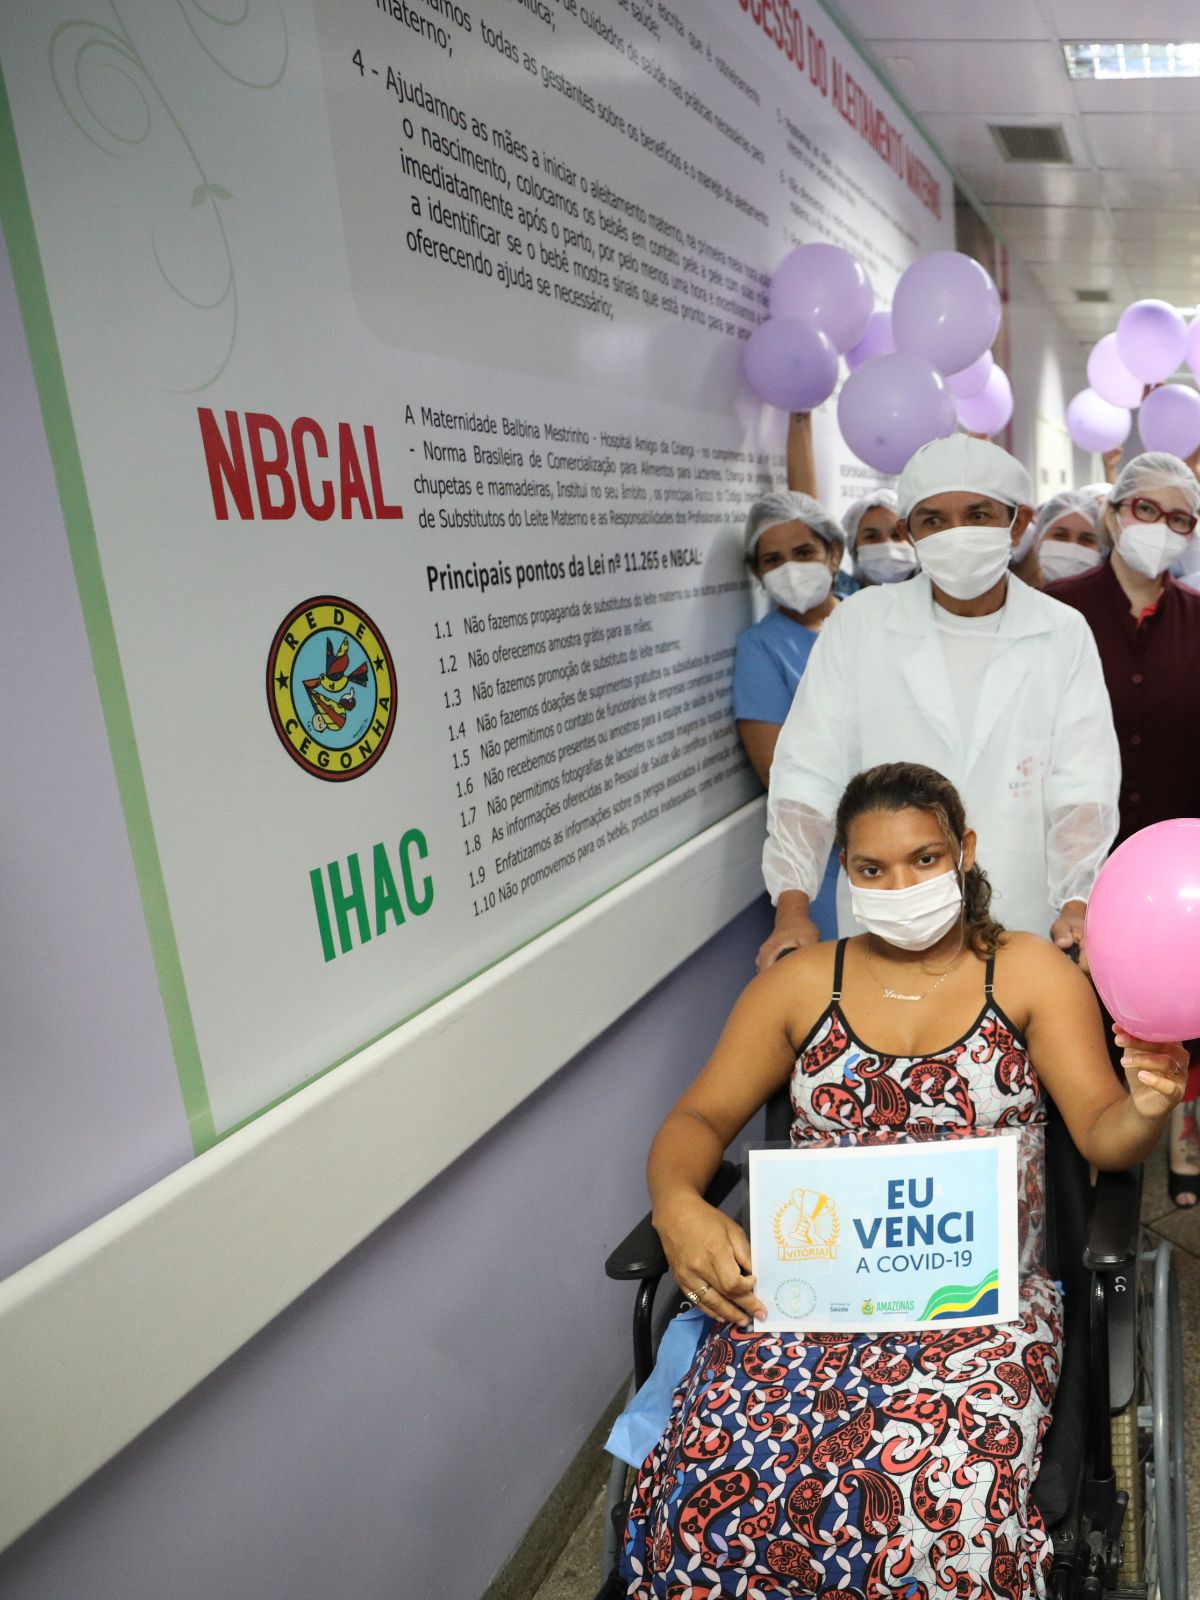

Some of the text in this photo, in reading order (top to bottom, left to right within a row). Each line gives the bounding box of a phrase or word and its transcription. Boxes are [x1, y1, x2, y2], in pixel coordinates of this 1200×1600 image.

[580, 7, 625, 54] cuidados
[807, 26, 828, 97] DO
[480, 19, 520, 63] todas
[523, 52, 538, 76] as
[541, 65, 596, 114] gestantes
[598, 103, 626, 134] sobre
[627, 123, 639, 142] os
[352, 49, 647, 224] 4 Ajudamos as mães a iniciar o aleitamento
[400, 146, 670, 287] imediatamente após o parto, por pelo menos
[402, 118, 680, 267] o nascimento, colocamos os bebês em contato
[406, 227, 615, 321] oferecendo ajuda se necessário;
[411, 195, 640, 301] a identificar se o bebê mostra sinais
[405, 404, 415, 425] A
[421, 405, 498, 435] Maternidade
[502, 417, 540, 440] Balbina
[544, 422, 590, 445] Mestrinho
[600, 430, 632, 451] Hospital
[423, 440, 616, 477] Norma Brasileira de Comercialização
[196, 406, 404, 521] NBCAL
[414, 473, 601, 501] chupetas e mamadeiras, Institui no
[418, 508, 435, 529] de
[439, 508, 505, 529] Substitutos
[508, 509, 522, 528] do
[524, 509, 549, 527] Leite
[551, 509, 588, 527] Materno
[426, 559, 513, 593] Principais
[516, 559, 565, 589] pontos
[568, 554, 585, 578] da
[587, 553, 605, 576] Lei
[608, 554, 621, 575] nº
[624, 550, 660, 573] 11.265
[662, 552, 669, 569] e
[283, 607, 367, 651] REDE
[434, 592, 633, 640] 1.1 Não fazemos propaganda de substitutos
[439, 654, 458, 674] 1.2
[468, 649, 490, 668] Não
[492, 641, 546, 664] oferecemos
[548, 632, 582, 653] amostra
[583, 623, 605, 649] grátis
[606, 622, 622, 642] para
[443, 688, 462, 709] 1.3
[472, 681, 494, 702] Não
[495, 674, 536, 696] fazemos
[537, 660, 580, 688] promoção
[592, 650, 628, 672] substituto
[448, 675, 633, 742] 1.4 Não fazemos doações suprimentos
[285, 695, 391, 770] CEGONHA
[453, 748, 470, 769] 1.5
[480, 740, 501, 760] Não
[503, 724, 555, 756] permitimos
[564, 710, 594, 732] contato
[456, 719, 641, 798] 1.6 Não recebemos presentes amostras
[460, 753, 604, 828] 1.7 Não permitimos fotografias
[464, 834, 482, 856] 1.8
[491, 827, 504, 844] As
[506, 802, 561, 838] informações
[562, 783, 603, 812] oferecidas
[614, 763, 639, 787] Pessoal
[468, 797, 633, 889] 1.9 Enfatizamos as informações sobre
[473, 890, 496, 918] 1.10
[498, 881, 519, 902] Não
[520, 852, 576, 895] promovemos
[577, 838, 596, 863] para
[606, 820, 631, 844] bebês,
[309, 827, 434, 963] IHAC
[887, 1176, 934, 1210] EU
[852, 1210, 974, 1249] VENCI
[855, 1249, 973, 1275] A COVID-19
[876, 1299, 915, 1312] AMAZONAS
